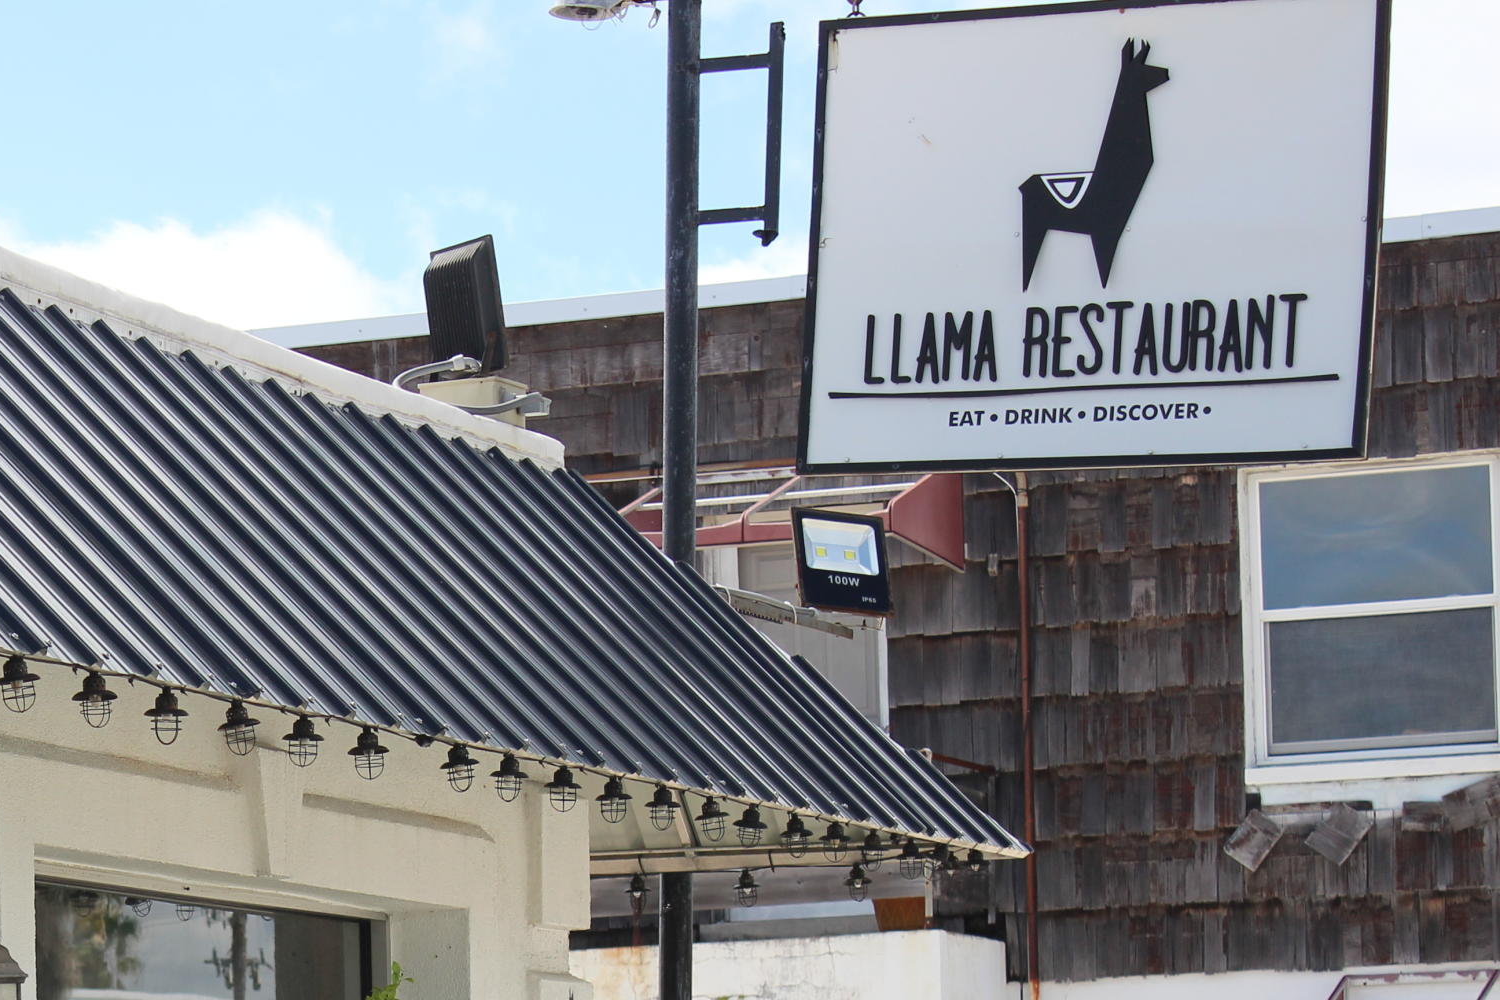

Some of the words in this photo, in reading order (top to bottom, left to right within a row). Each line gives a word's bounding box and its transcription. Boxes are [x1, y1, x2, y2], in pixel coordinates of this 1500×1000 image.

[863, 309, 998, 386] LLAMA
[1022, 292, 1308, 378] RESTAURANT
[948, 409, 986, 427] EAT
[1004, 406, 1072, 425] DRINK
[827, 575, 860, 587] 100W
